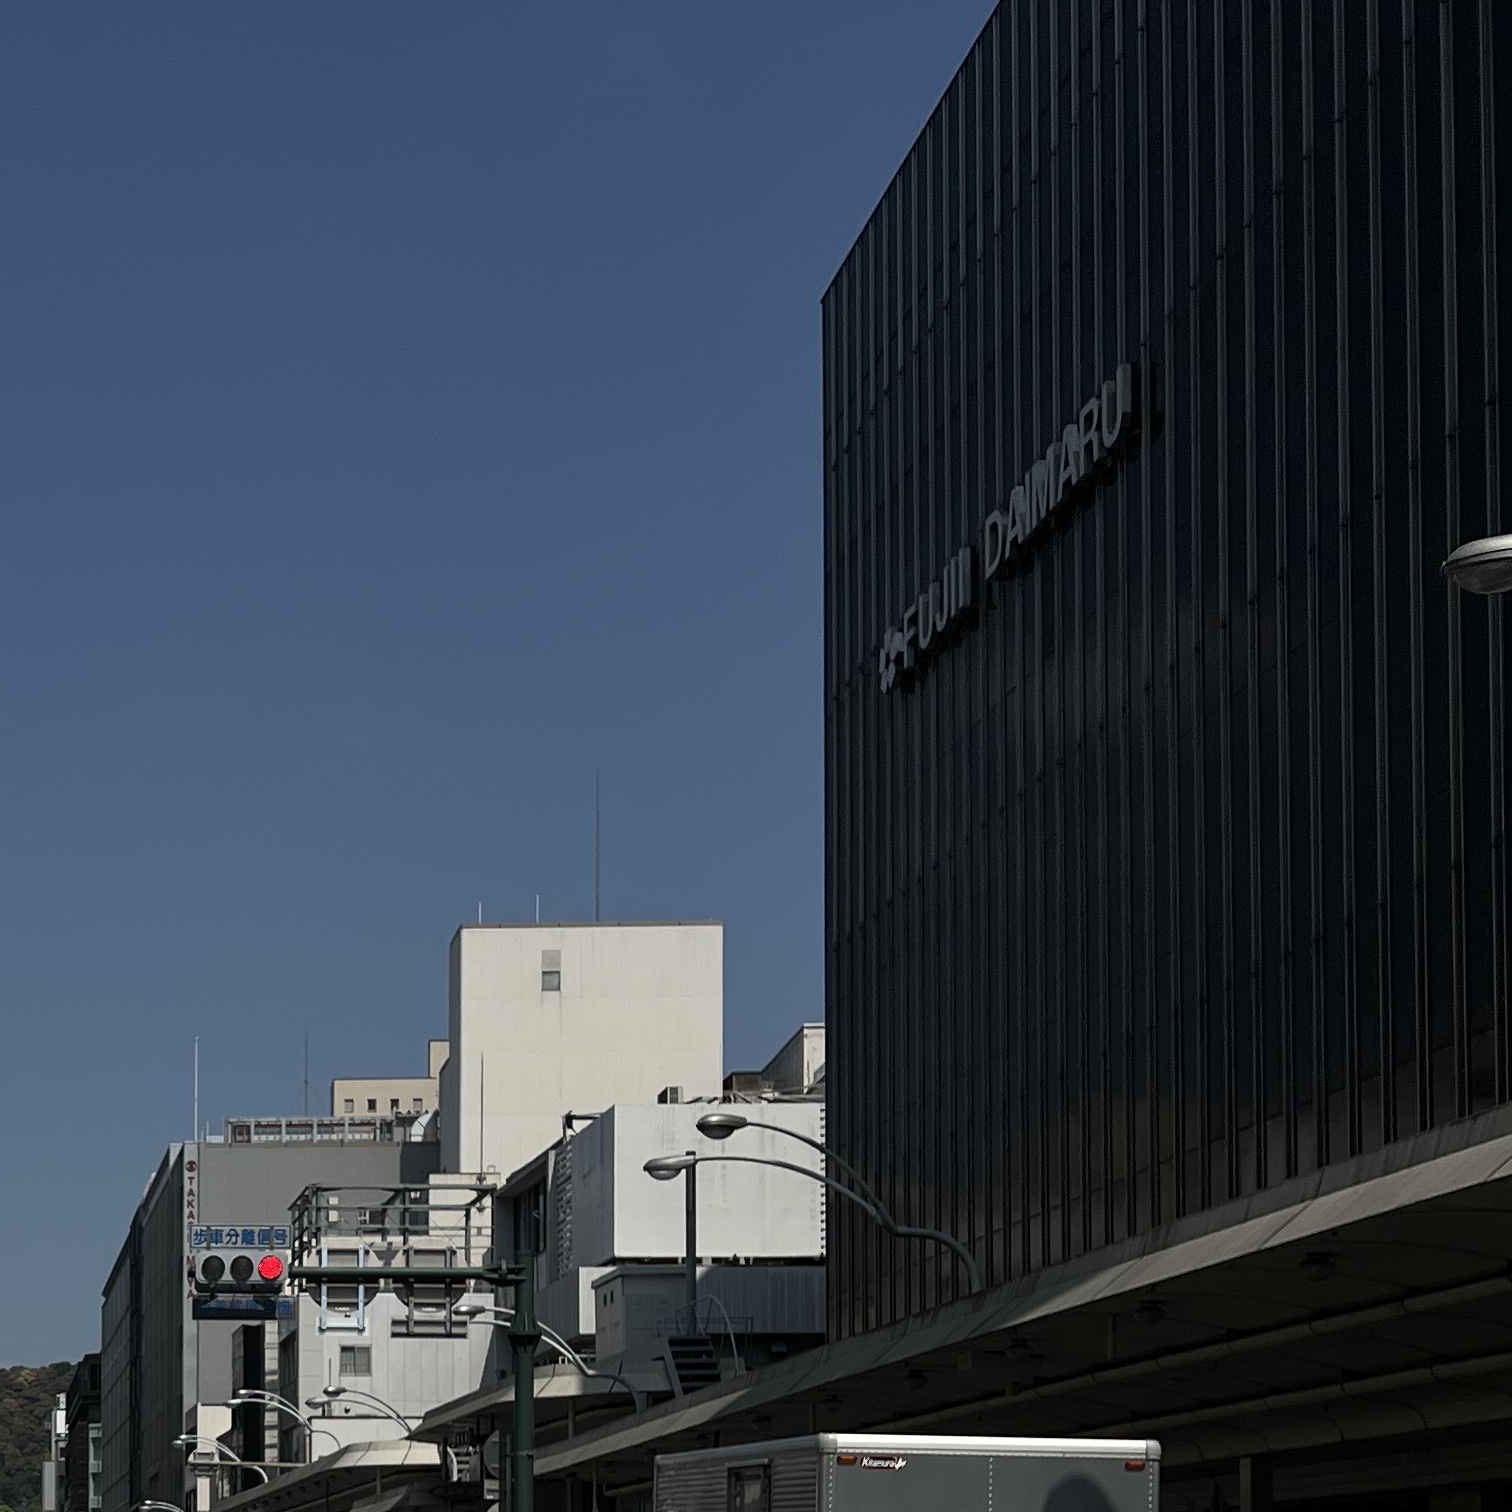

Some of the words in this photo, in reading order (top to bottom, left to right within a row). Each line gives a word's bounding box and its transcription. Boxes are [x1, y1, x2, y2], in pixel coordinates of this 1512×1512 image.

[985, 363, 1133, 579] DAIMARU
[193, 1228, 287, 1246] 歩車分離信号
